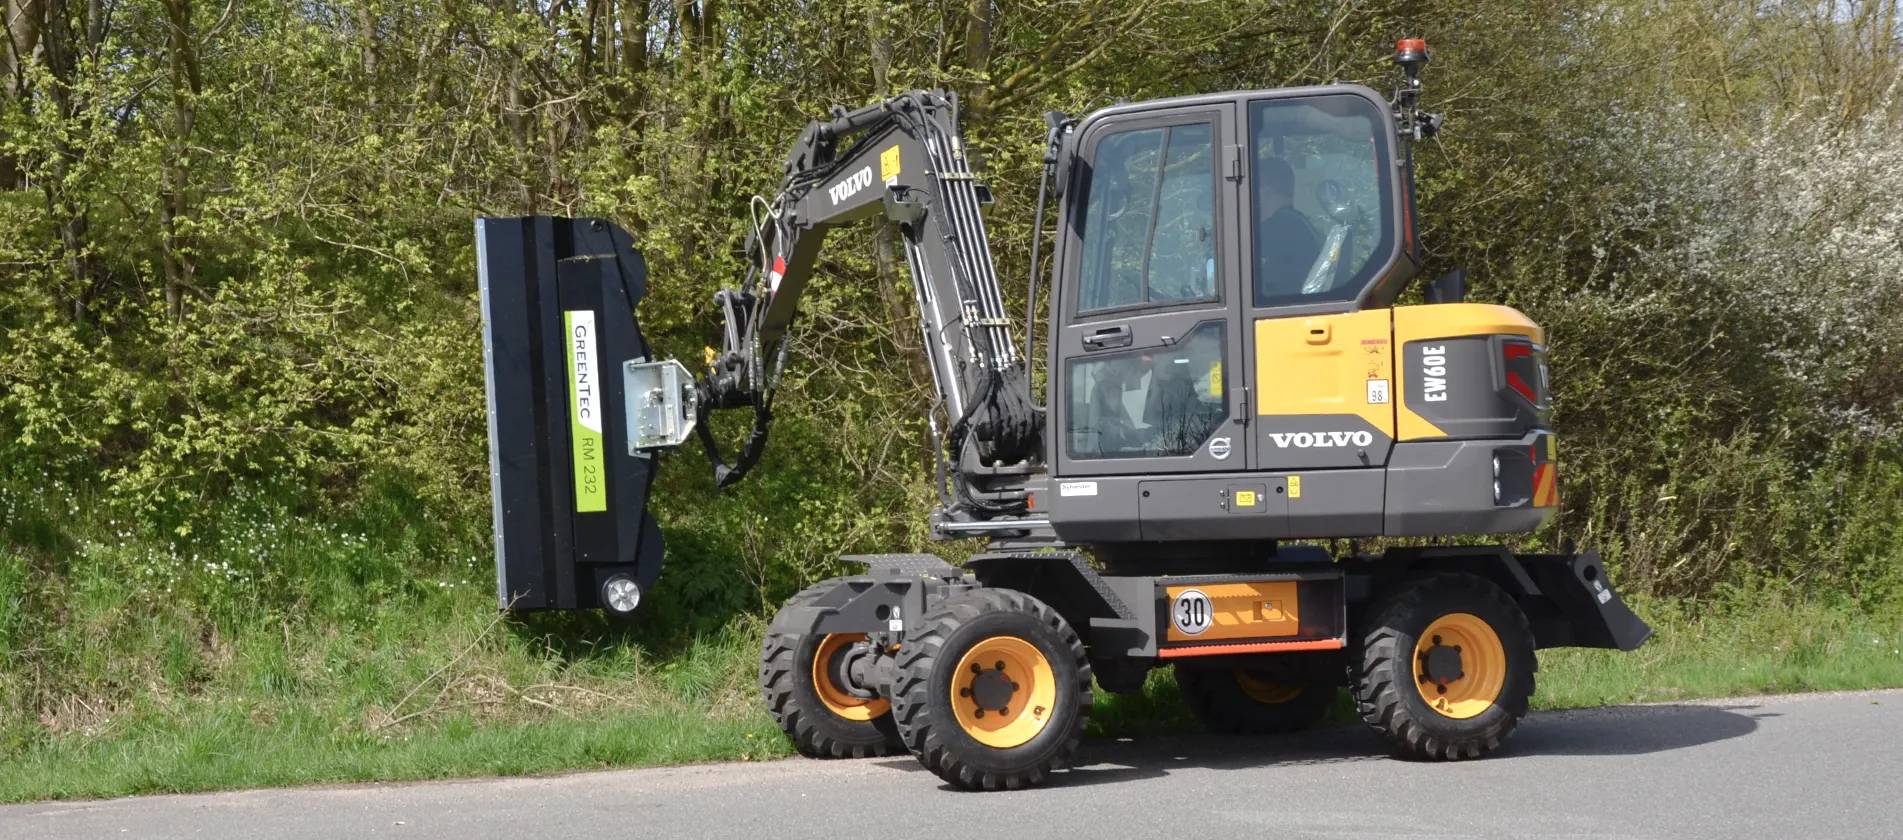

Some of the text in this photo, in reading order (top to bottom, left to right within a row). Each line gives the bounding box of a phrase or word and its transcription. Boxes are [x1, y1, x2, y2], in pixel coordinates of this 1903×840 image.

[829, 166, 872, 205] VOLVO
[1423, 345, 1447, 402] EW60E
[1372, 390, 1383, 402] 98
[1269, 430, 1373, 448] VOLVO
[582, 437, 597, 494] RM 232
[1180, 598, 1205, 628] 30
